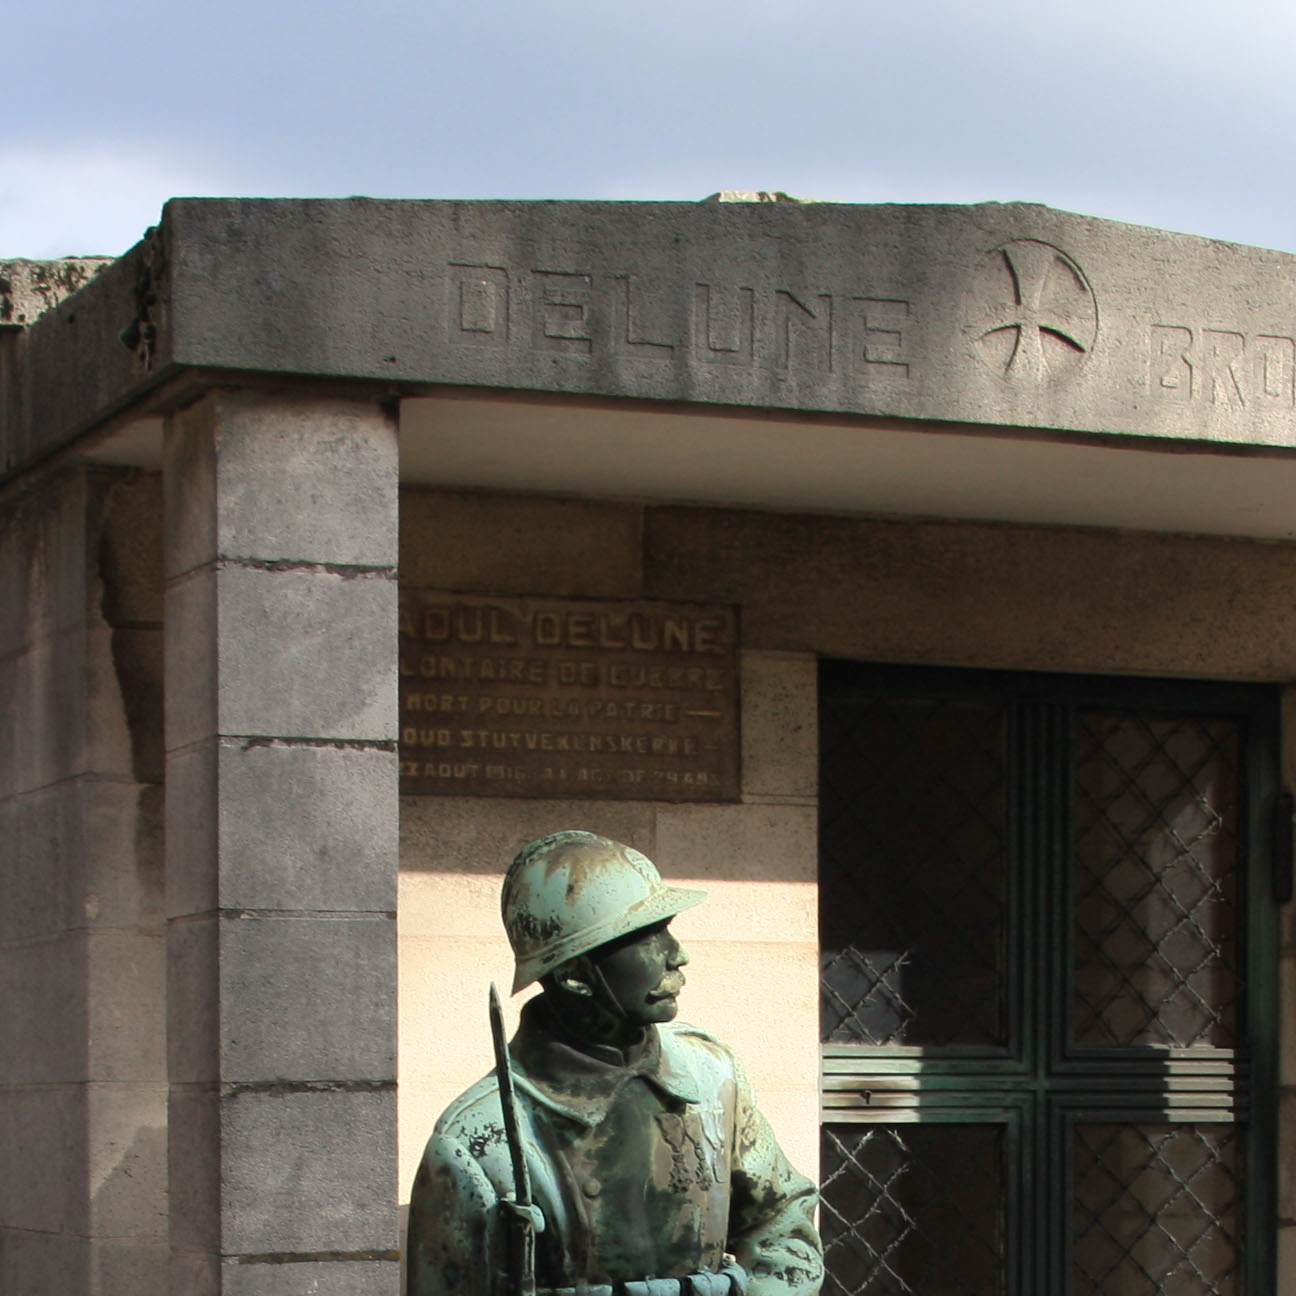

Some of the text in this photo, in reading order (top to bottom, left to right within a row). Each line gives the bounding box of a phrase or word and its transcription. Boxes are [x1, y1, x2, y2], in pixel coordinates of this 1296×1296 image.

[447, 258, 910, 385] DELUNE
[535, 611, 724, 656] DELUNE
[559, 661, 596, 685] DE
[610, 663, 724, 691] GUERRE
[406, 694, 679, 722] MORT POUR LA PATRIE
[403, 727, 451, 746] OUD
